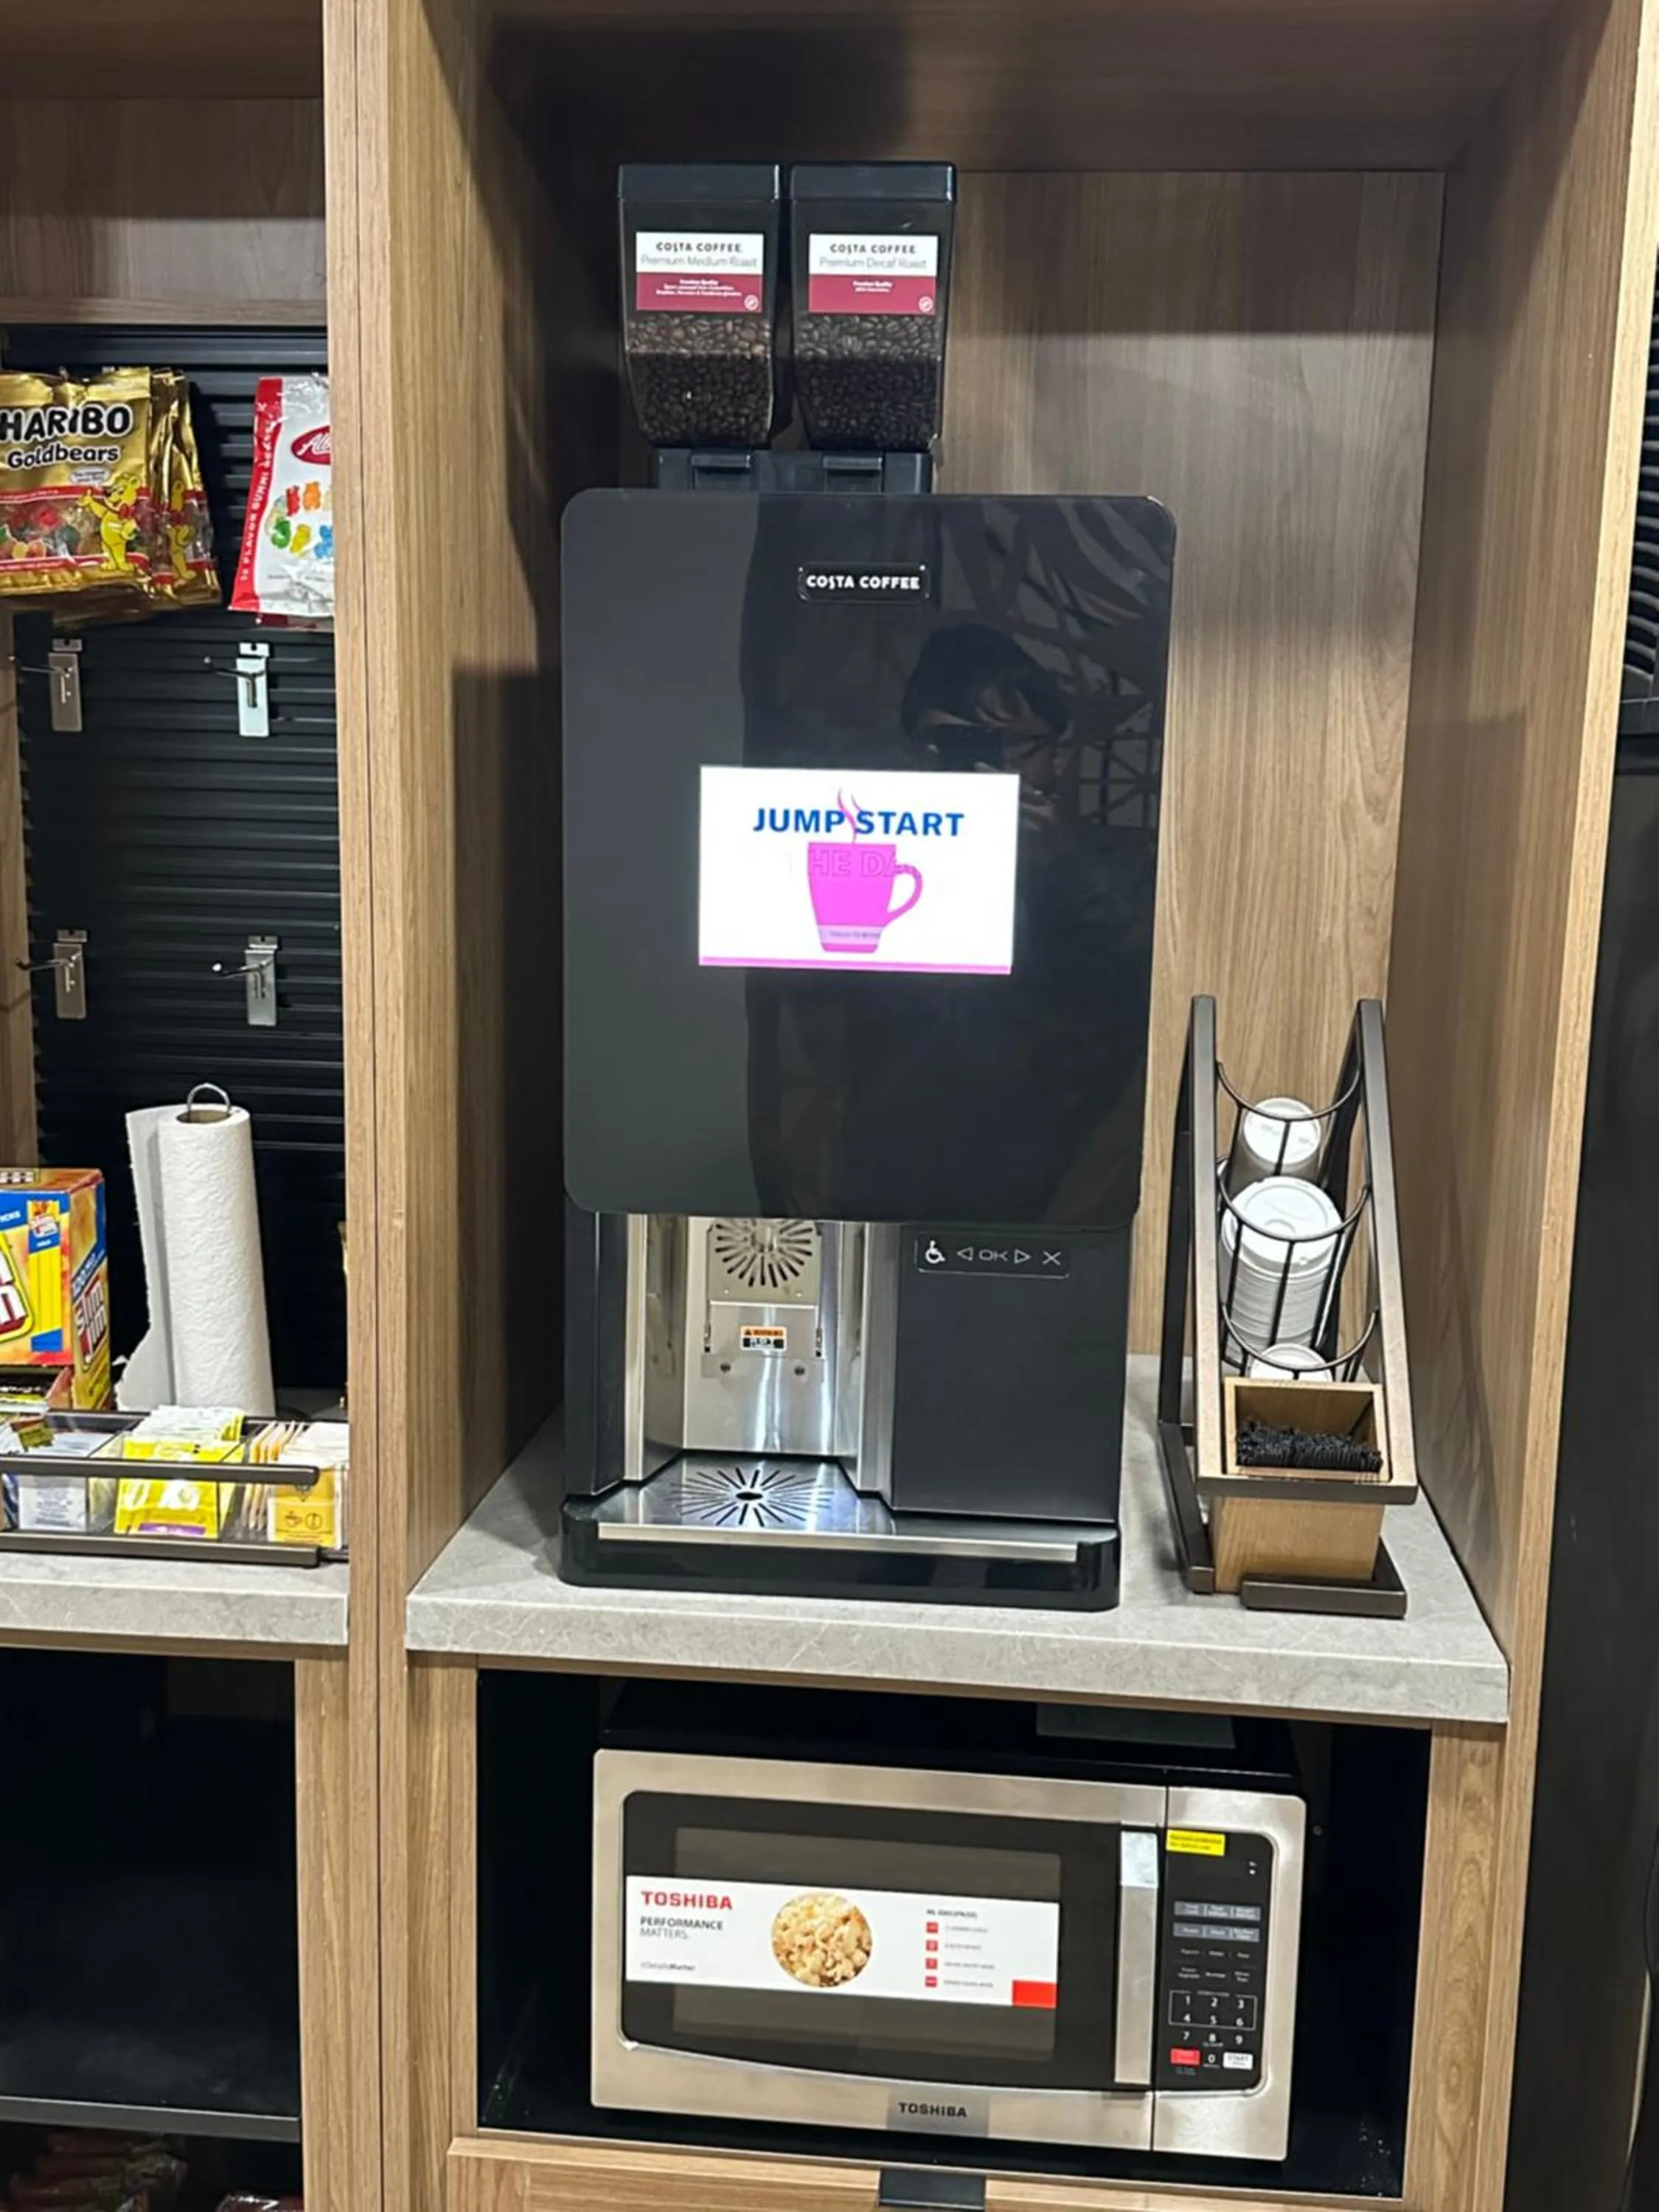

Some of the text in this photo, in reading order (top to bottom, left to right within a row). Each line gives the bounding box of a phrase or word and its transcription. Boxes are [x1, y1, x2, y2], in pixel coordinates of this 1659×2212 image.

[655, 242, 742, 253] COSTA COFFEE
[830, 243, 917, 254] COSTA COFFEE
[640, 254, 758, 268] Premium Medium Roast
[819, 257, 928, 269] Premium Decaf Roast
[0, 406, 132, 442] HARIBO
[7, 443, 119, 469] Goldbears
[806, 574, 921, 590] COSTA COFFEE
[753, 808, 965, 837] JUMP START
[978, 1250, 1009, 1262] OK
[640, 1890, 733, 1910] TOSHIBA
[640, 1916, 723, 1930] PERFORMANCE
[897, 2101, 967, 2118] TOSHIBA
